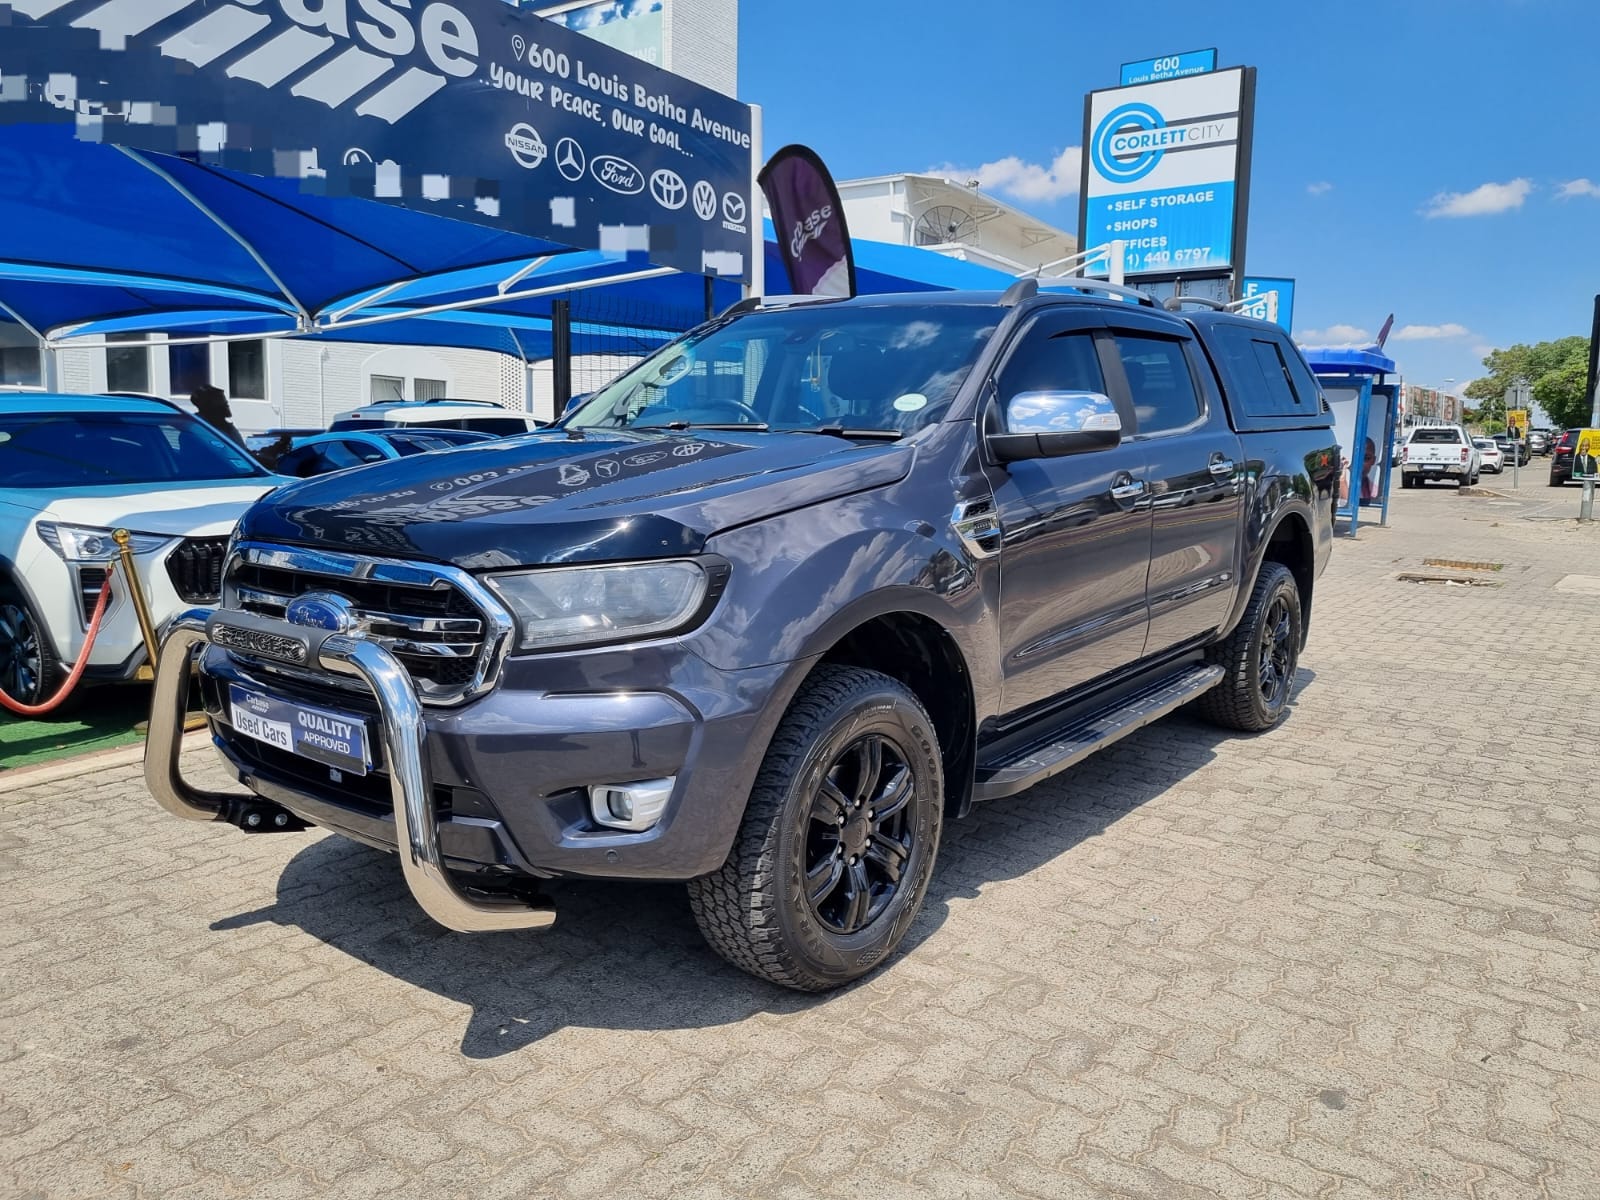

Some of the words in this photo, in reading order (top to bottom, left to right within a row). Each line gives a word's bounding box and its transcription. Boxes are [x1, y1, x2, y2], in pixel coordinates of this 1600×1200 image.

[1128, 74, 1149, 84] Louis
[1150, 71, 1173, 81] Botha
[1174, 66, 1205, 77] Avenue
[1153, 56, 1180, 72] 600
[528, 43, 570, 79] 600
[577, 60, 629, 102] Louis
[634, 83, 686, 125] Botha
[691, 108, 750, 149] Avenue
[612, 108, 643, 137] OUR
[507, 136, 546, 155] NISSAN
[1114, 128, 1187, 151] CORLETT
[1188, 123, 1225, 141] CITY
[601, 160, 635, 188] Ford
[1115, 198, 1147, 212] SELF
[1150, 190, 1215, 208] STORAGE
[1114, 218, 1158, 232] SHOPS
[1123, 235, 1168, 250] FFICES
[1143, 251, 1171, 264] 440
[1174, 247, 1211, 261] 6797
[235, 710, 260, 736] Used
[262, 720, 288, 746] Cars
[298, 711, 352, 740] QUALITY
[303, 731, 350, 755] APPROVED
